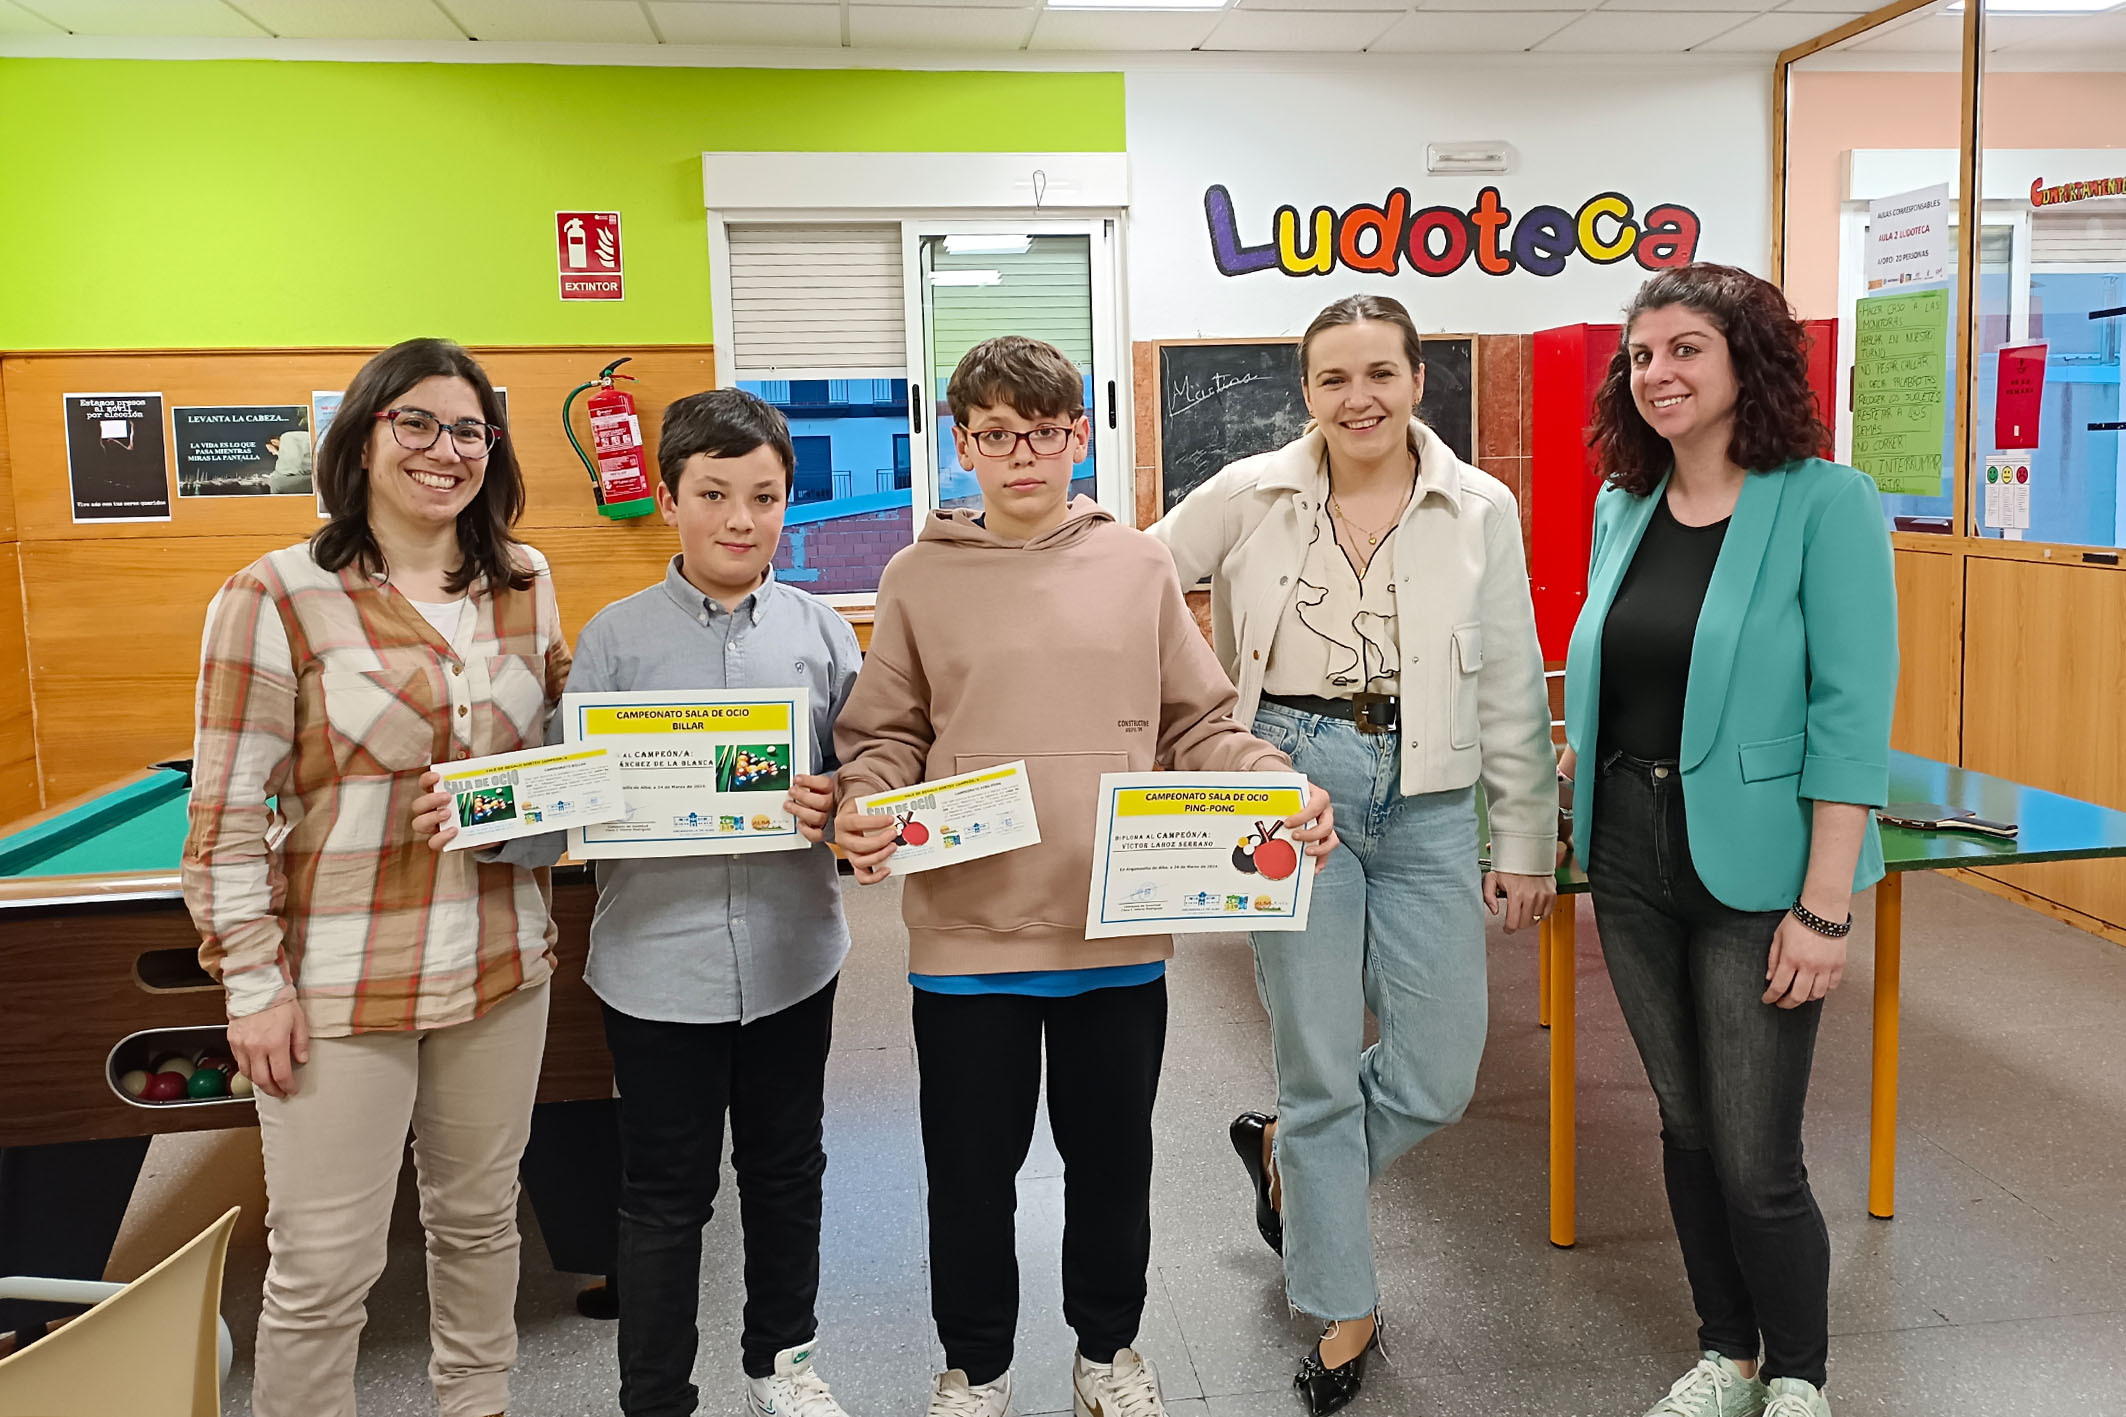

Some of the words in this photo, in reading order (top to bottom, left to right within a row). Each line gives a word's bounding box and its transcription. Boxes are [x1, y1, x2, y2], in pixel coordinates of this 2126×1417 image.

[1877, 211, 1892, 219] AULAS
[1205, 184, 1700, 278] Ludoteca
[1878, 232, 1893, 242] AULA
[1894, 231, 1899, 240] 2
[1899, 224, 1930, 239] LUDOTECA
[1902, 249, 1929, 261] PERSONAS
[565, 282, 618, 291] EXTINTOR
[1925, 301, 1940, 312] LAS
[80, 399, 115, 408] Estamos
[87, 412, 102, 420] por
[104, 410, 144, 418] elección
[188, 415, 231, 423] LEVANTA
[616, 709, 683, 720] CAMPEONATO
[685, 709, 709, 718] SALA
[711, 709, 723, 717] DE
[726, 708, 750, 717] OCIO
[672, 721, 704, 731] BILLAR
[681, 759, 714, 767] BLANCA
[475, 777, 490, 788] DE
[491, 768, 519, 786] OCIO
[1145, 792, 1207, 801] CAMPEONATO
[1208, 792, 1231, 801] SALA
[1233, 793, 1245, 801] DE
[1246, 793, 1269, 801] OCIO
[895, 803, 909, 812] DE
[910, 793, 937, 811] OCIO
[1184, 804, 1235, 813] PING-PONG
